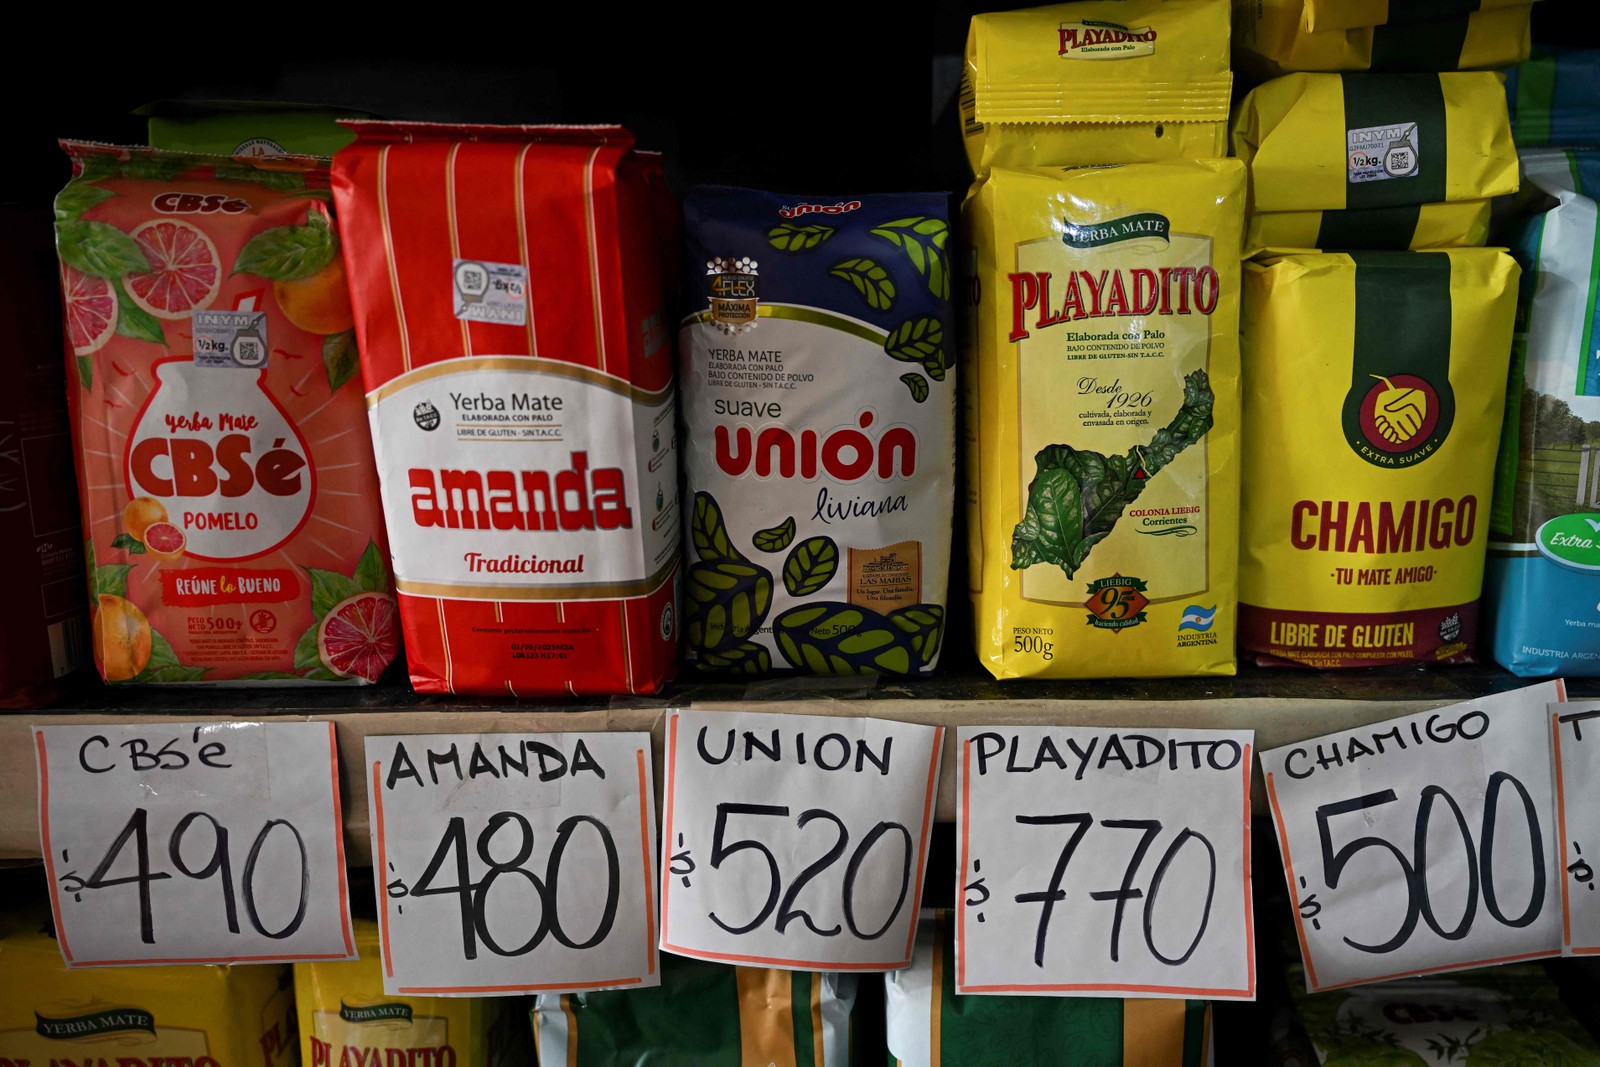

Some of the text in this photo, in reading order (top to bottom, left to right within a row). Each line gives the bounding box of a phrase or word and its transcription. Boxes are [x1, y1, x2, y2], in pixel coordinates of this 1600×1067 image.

[1058, 29, 1157, 55] PLAYADITO
[1353, 128, 1401, 143] INYM
[1121, 219, 1165, 235] MATE
[1008, 265, 1220, 343] PLAYADITO
[197, 313, 248, 326] INYM
[1066, 331, 1120, 341] Elaborada
[1143, 330, 1165, 339] Palo
[708, 348, 782, 363] YERBA MATE
[1086, 343, 1129, 351] CONTENIDO
[708, 362, 747, 371] ELABORADA
[765, 364, 784, 372] PALO
[708, 371, 814, 382] BAJO CONTENIDO DE POLVO
[1077, 377, 1122, 394] Desde
[449, 393, 563, 411] Yerba Mate
[1107, 390, 1154, 409] 1926
[714, 399, 782, 418] suave
[1113, 409, 1146, 418] elaborada
[1083, 418, 1114, 426] envasada
[457, 428, 476, 436] LIBRE
[477, 428, 487, 436] DE
[1360, 444, 1433, 465] EXTRA SUAVE
[130, 434, 306, 497] CBSé
[408, 451, 633, 531] amanda
[811, 487, 908, 524] liviana
[1130, 506, 1200, 517] COLONIA LIEBIG
[183, 511, 258, 531] POMELO
[1142, 517, 1187, 526] Corrientes
[1290, 494, 1478, 554] CHAMIGO
[1550, 532, 1593, 549] Extra
[463, 552, 584, 573] Tradicional
[1100, 578, 1132, 588] LIEBIG
[1357, 567, 1391, 586] MATE
[1394, 565, 1434, 585] AMIGO
[176, 575, 281, 595] REÚNE lo BUENO
[1100, 588, 1134, 619] 95
[206, 617, 243, 630] 500g
[1033, 627, 1053, 635] NETO
[1564, 618, 1586, 627] Yerba
[1177, 632, 1217, 641] INDUSTRIA
[1177, 639, 1217, 647] ARGENTINA
[1270, 621, 1320, 647] LIBRE
[1324, 624, 1347, 648] DE
[1351, 622, 1415, 648] GLUTEN
[1014, 635, 1053, 660] 500g
[1522, 645, 1569, 658] INDUSTRIA
[696, 725, 894, 776] UNION
[1285, 710, 1490, 780] CHAMIGO
[385, 738, 606, 790] AMANDA
[969, 731, 1243, 782] PLAYADITO
[344, 1006, 409, 1020] YERBA MATE
[43, 1014, 150, 1035] YERBA MATE
